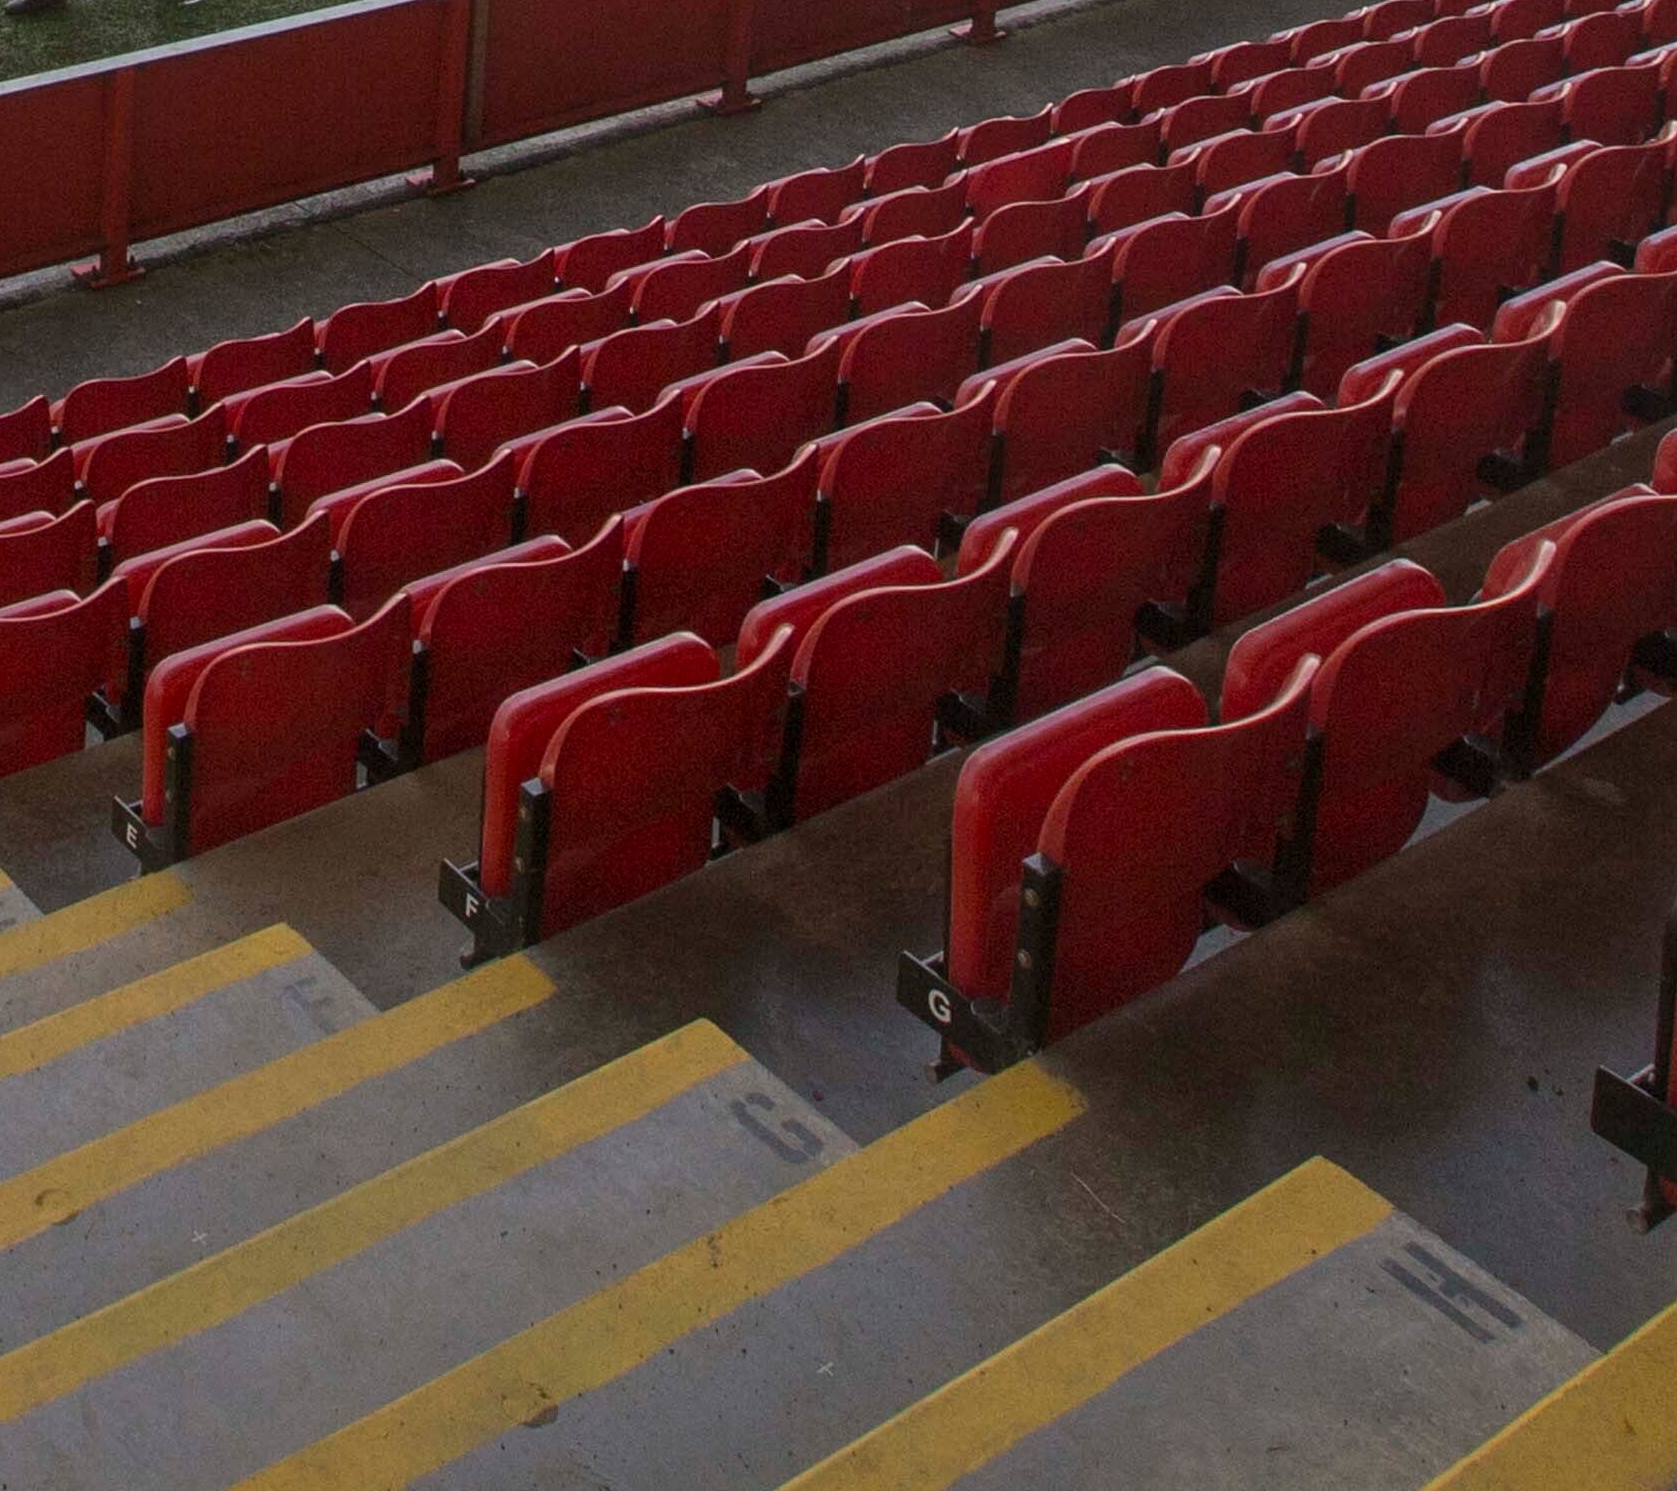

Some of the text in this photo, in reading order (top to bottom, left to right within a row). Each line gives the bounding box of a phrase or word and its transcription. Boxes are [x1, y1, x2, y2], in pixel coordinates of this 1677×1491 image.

[126, 822, 138, 849] E
[465, 892, 480, 919] F
[927, 988, 952, 1024] G
